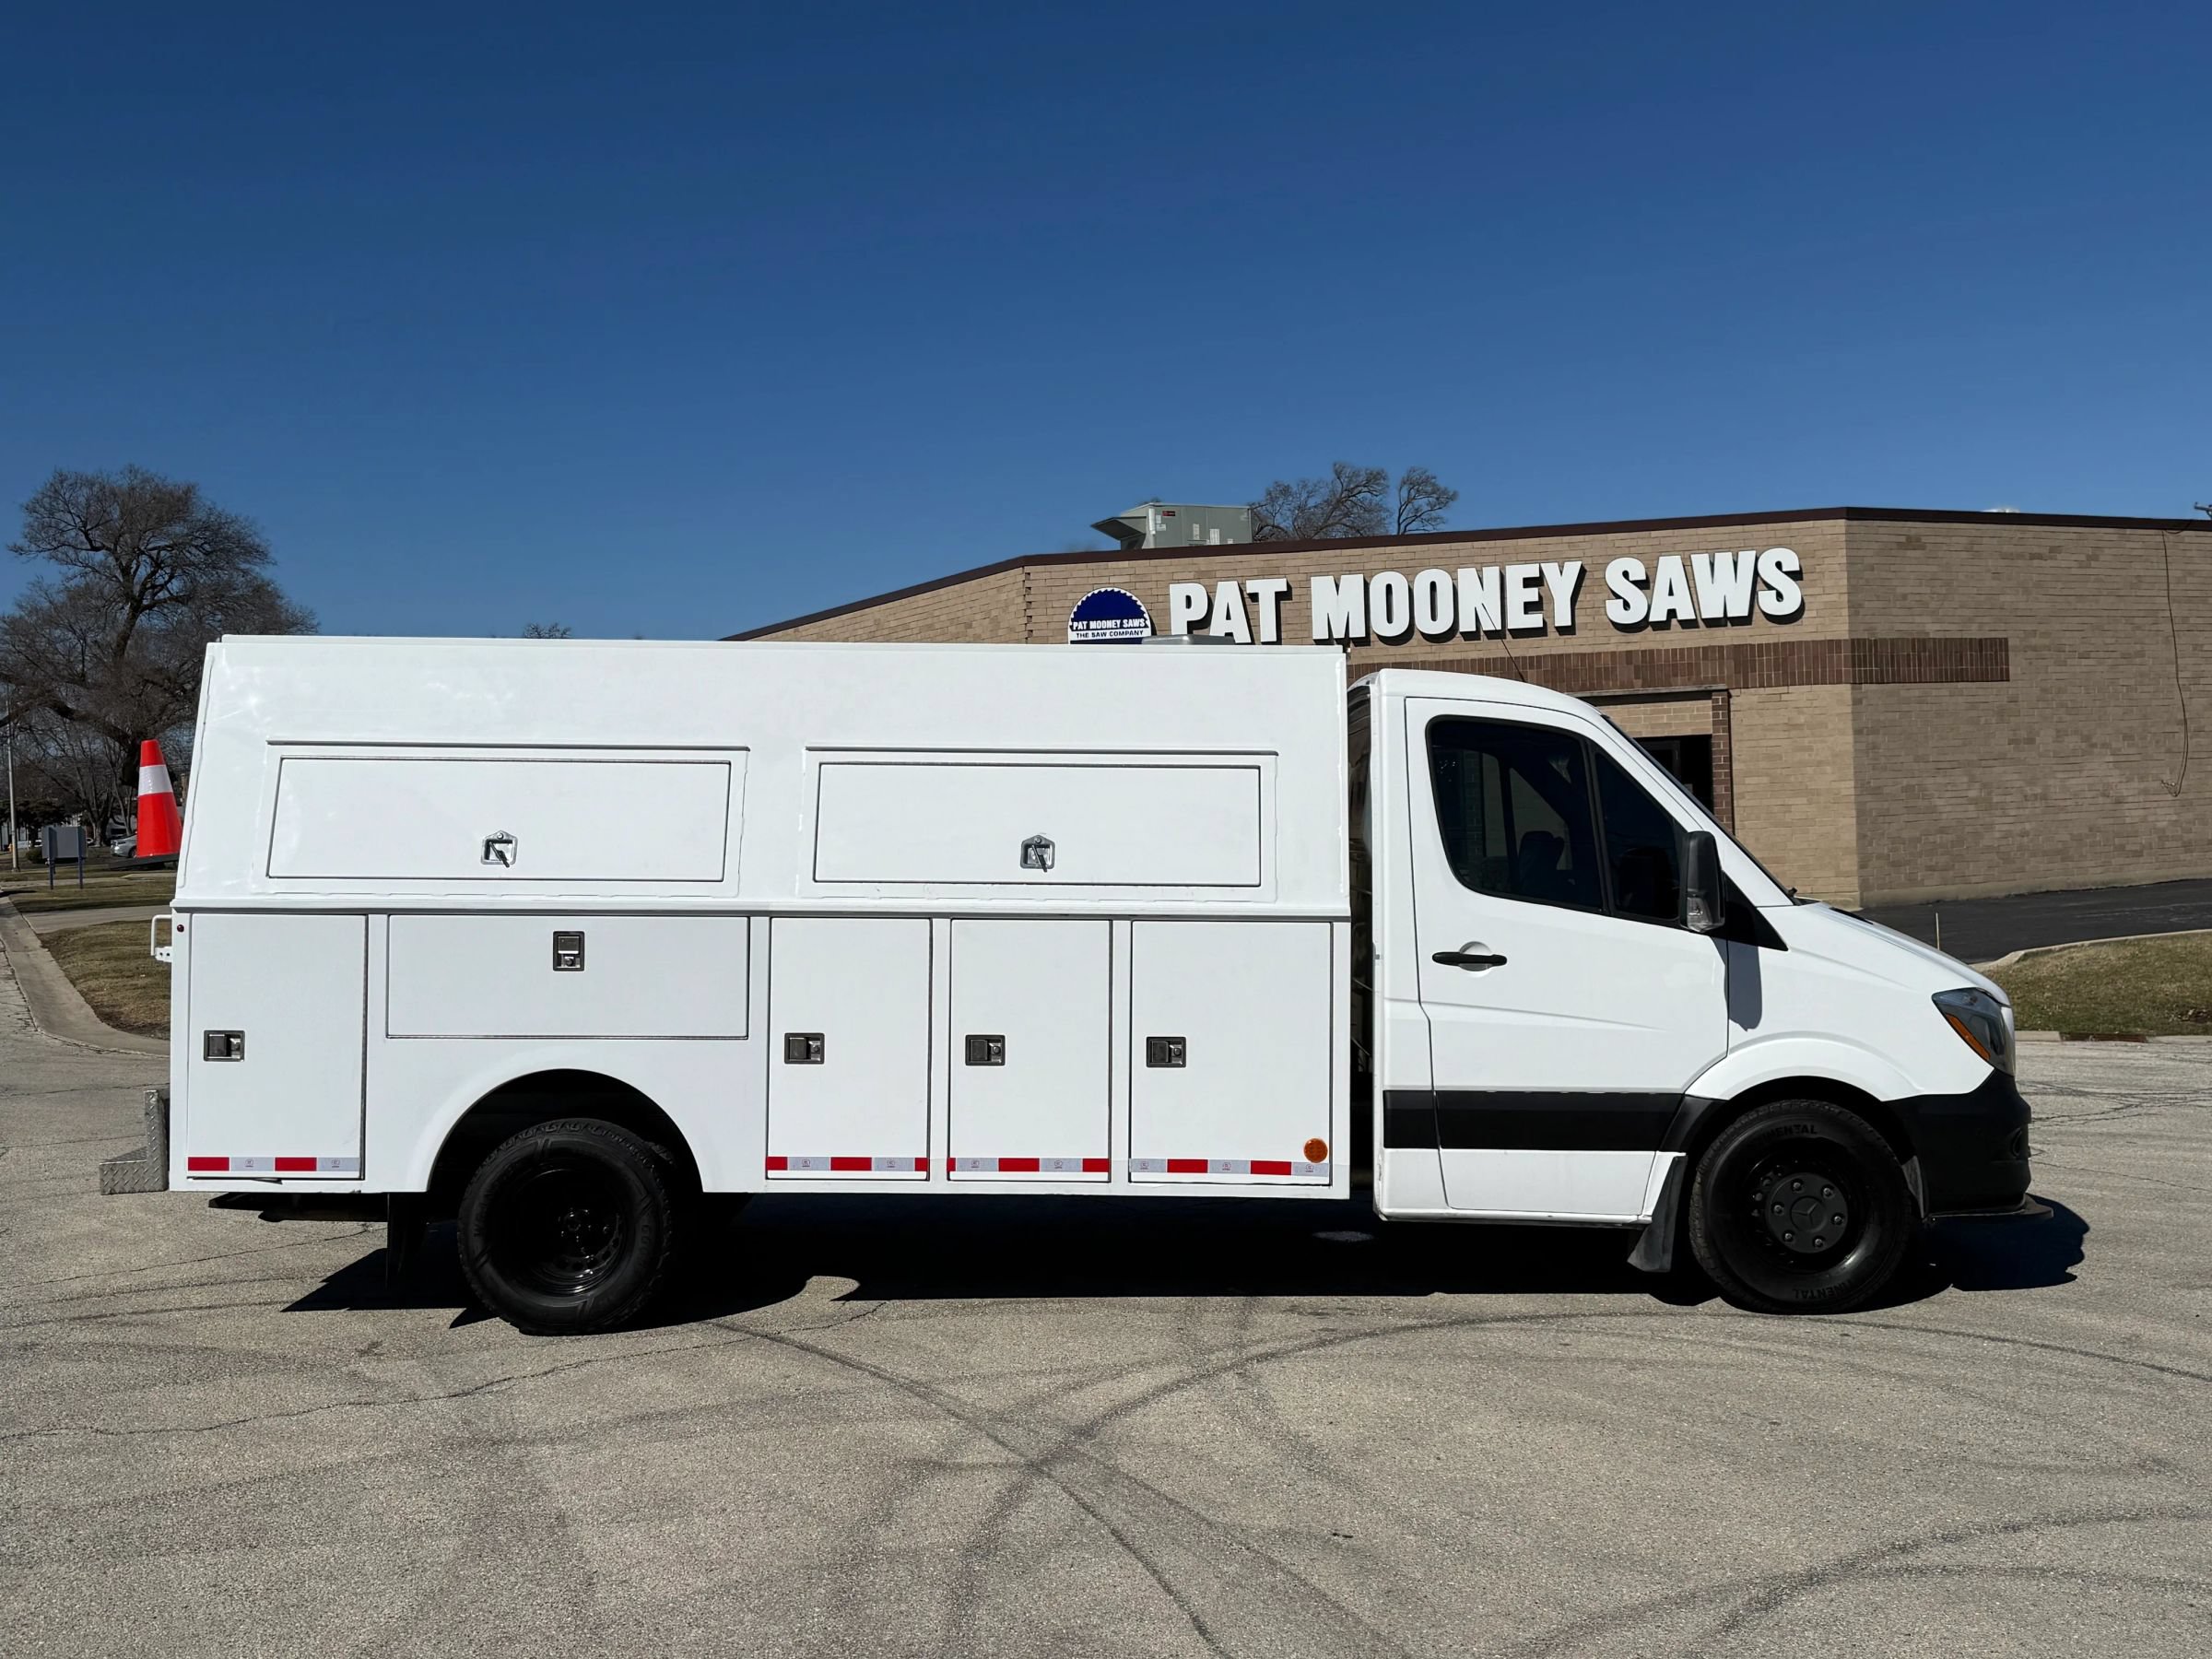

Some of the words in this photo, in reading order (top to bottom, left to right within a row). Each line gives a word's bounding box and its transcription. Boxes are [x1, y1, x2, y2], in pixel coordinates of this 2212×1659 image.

[1169, 578, 1288, 643] PAT
[1310, 560, 1583, 640] MOONEY
[1605, 547, 1803, 624] SAWS
[1073, 621, 1088, 630] PAT
[1089, 619, 1122, 629] MOONEY
[1123, 618, 1146, 628] SAWS
